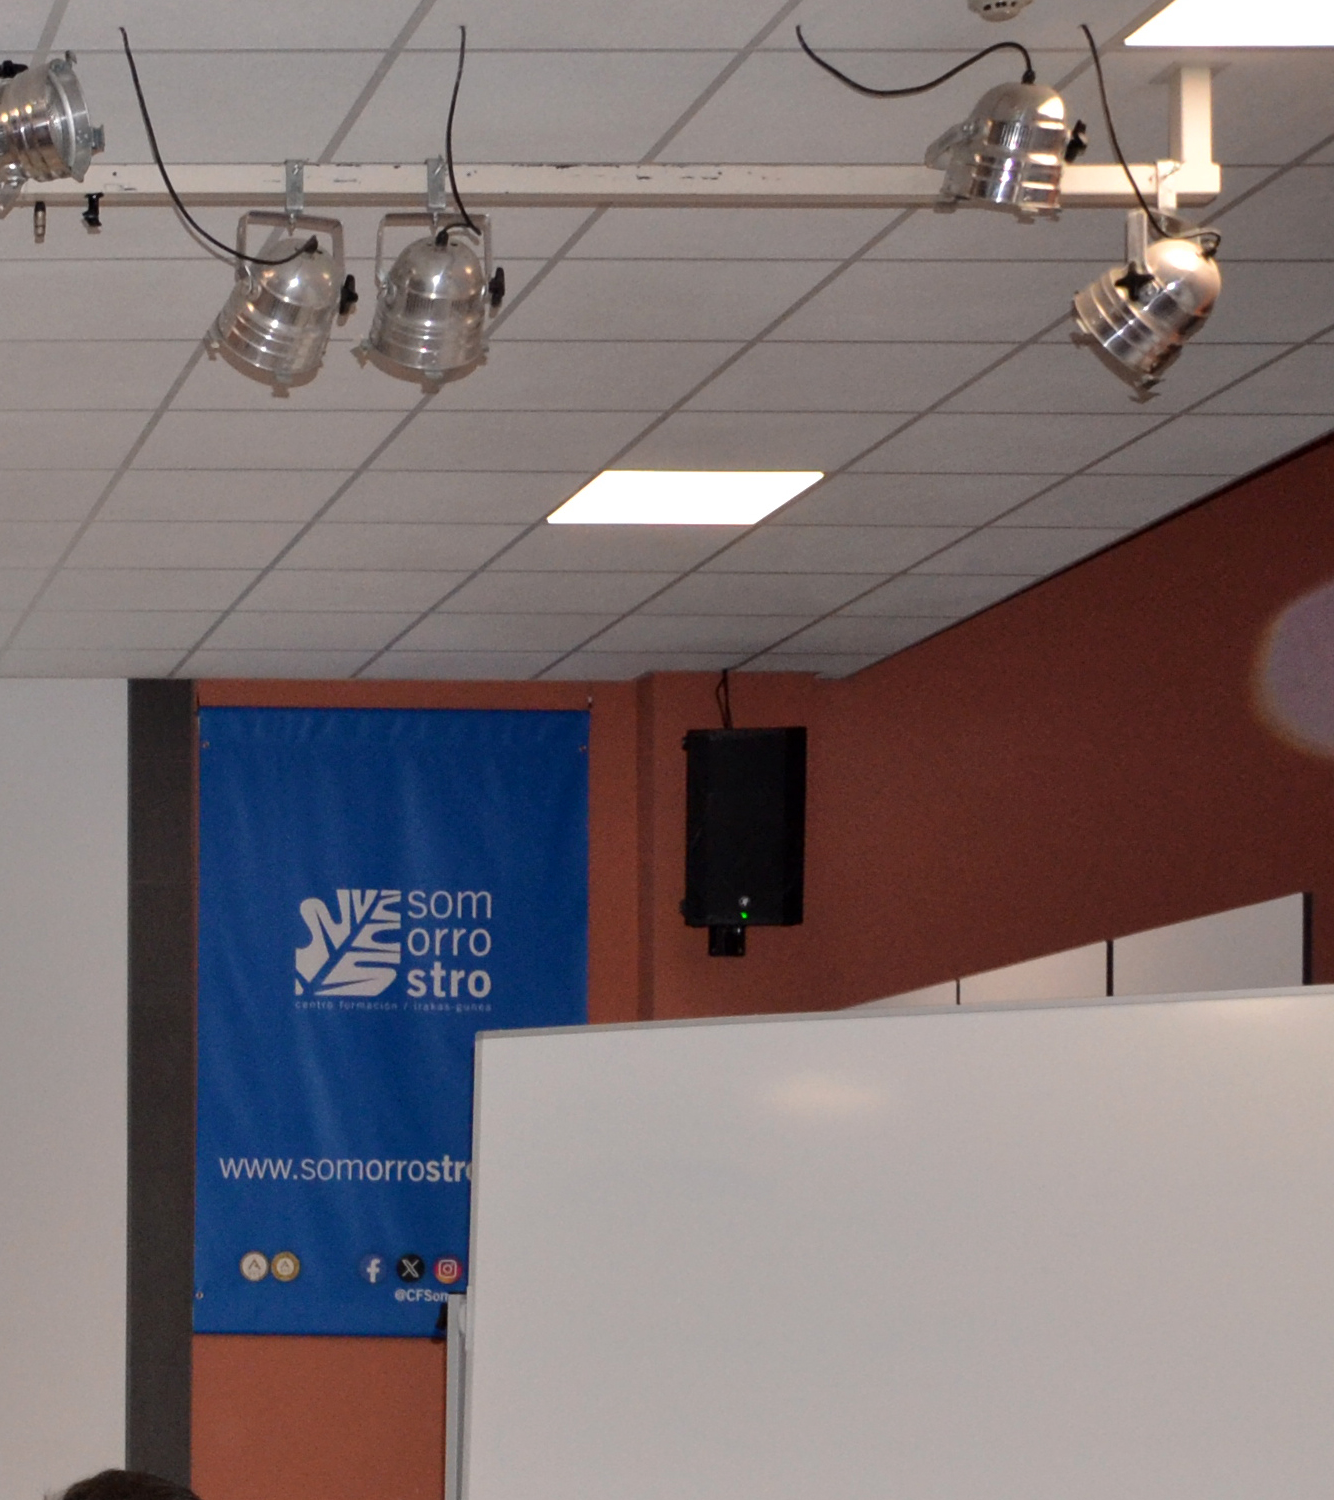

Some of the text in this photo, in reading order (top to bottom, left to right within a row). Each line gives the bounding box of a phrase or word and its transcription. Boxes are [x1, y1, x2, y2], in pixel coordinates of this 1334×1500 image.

[407, 890, 492, 919] som
[407, 927, 492, 957] orro
[407, 961, 492, 998] stro
